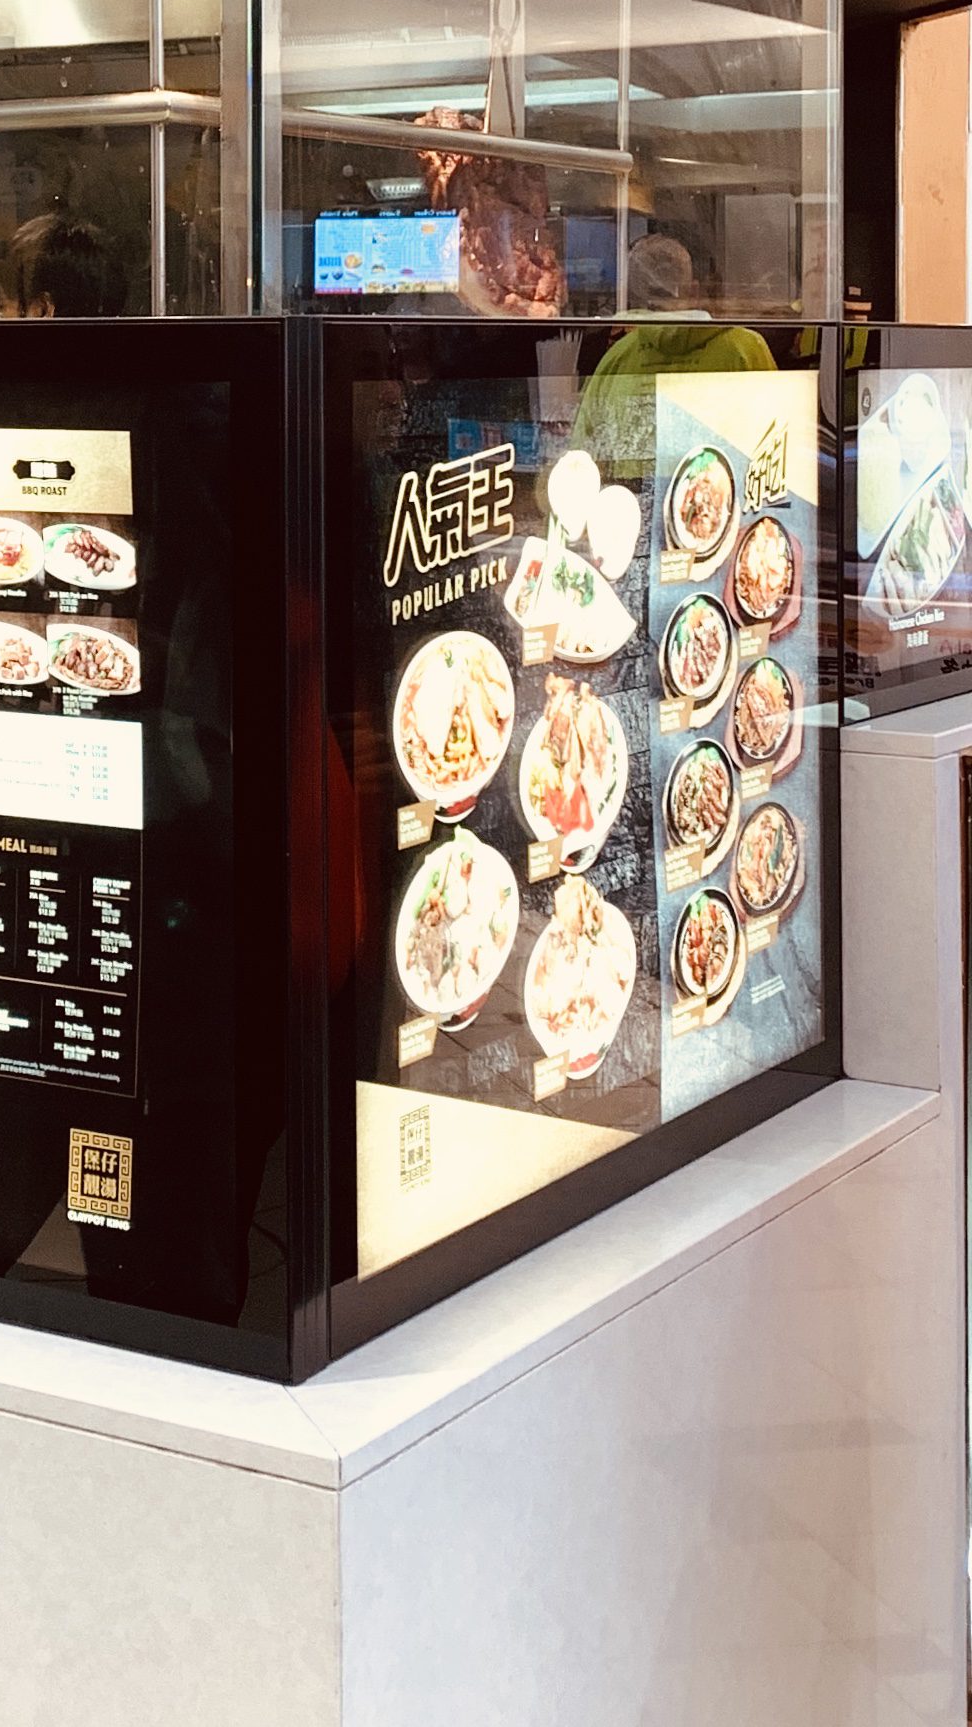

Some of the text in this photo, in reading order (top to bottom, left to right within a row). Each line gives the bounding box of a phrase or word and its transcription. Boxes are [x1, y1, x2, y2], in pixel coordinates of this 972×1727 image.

[22, 485, 68, 497] BBQ ROAST
[392, 556, 508, 625] POPULAR PICK
[67, 1210, 131, 1231] CLAYPOT KING
